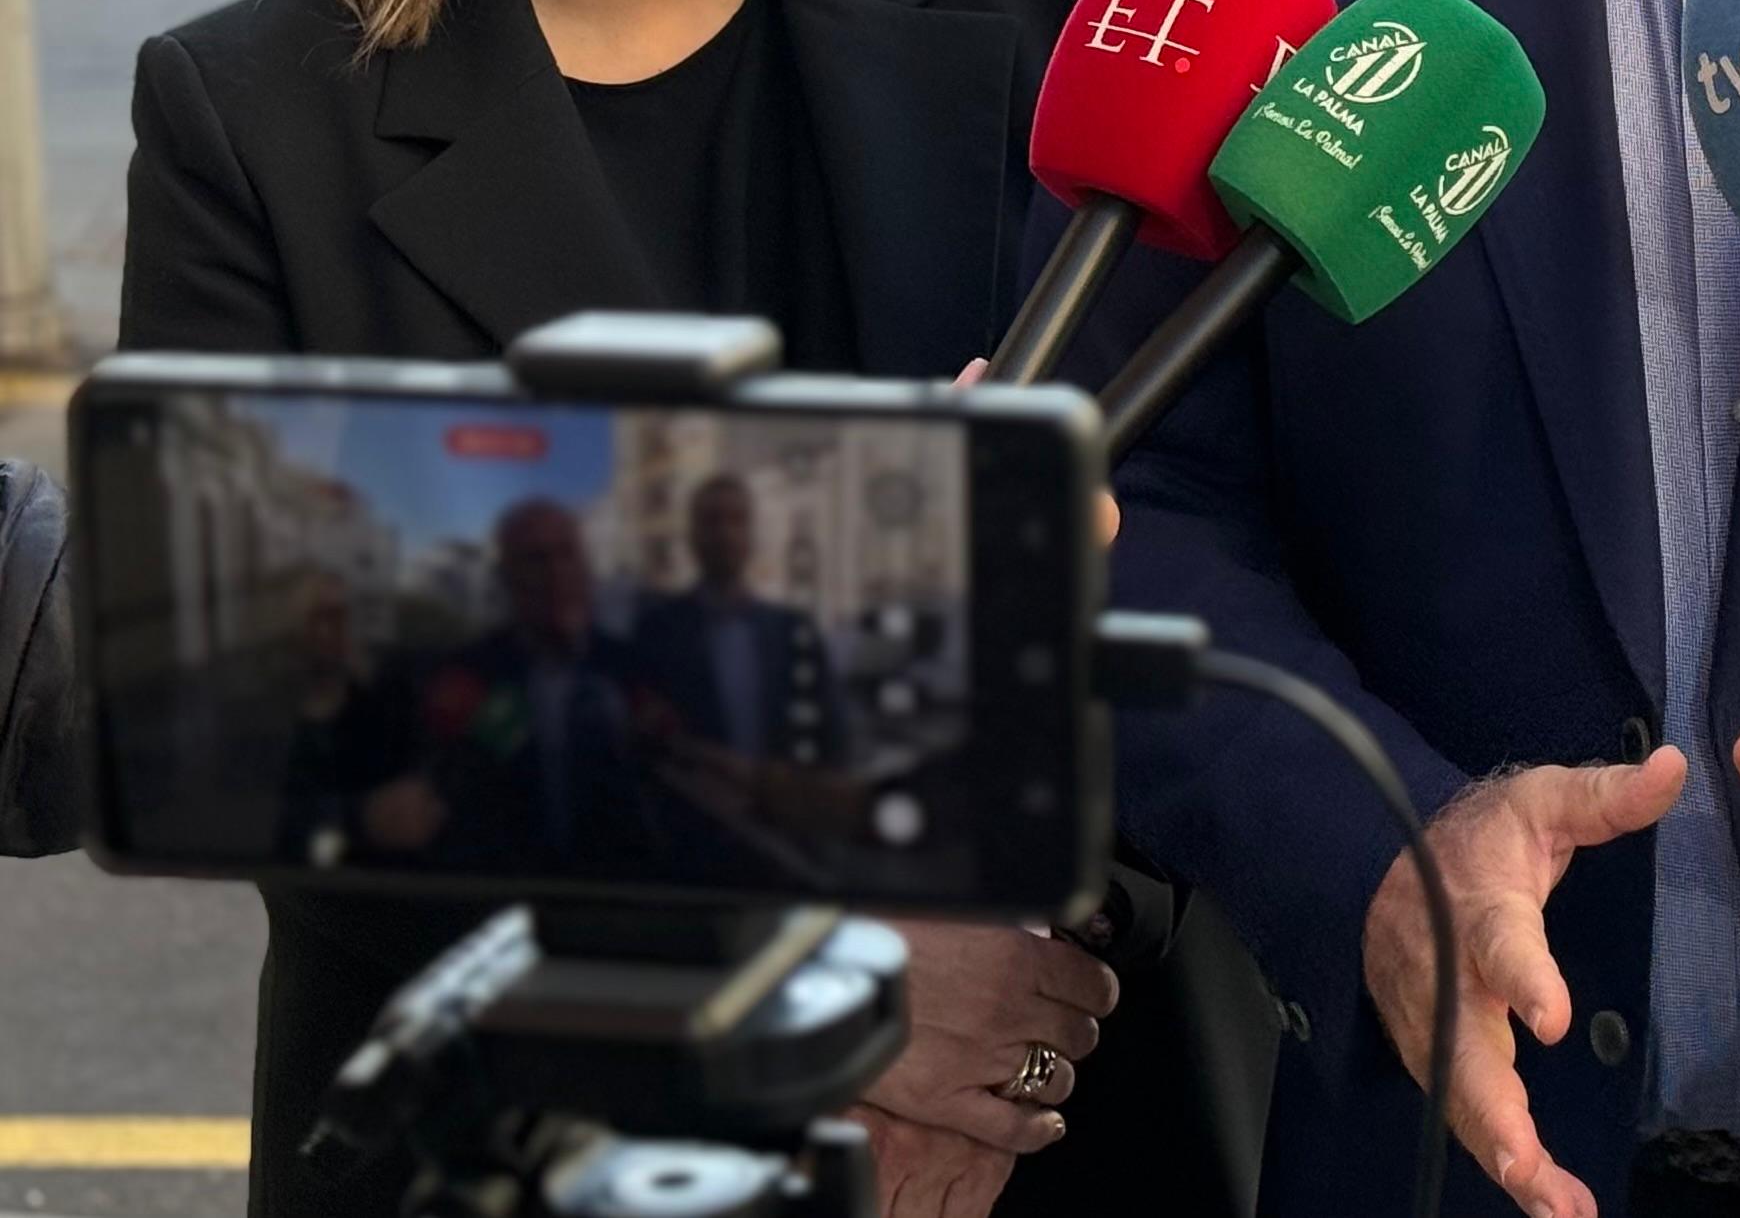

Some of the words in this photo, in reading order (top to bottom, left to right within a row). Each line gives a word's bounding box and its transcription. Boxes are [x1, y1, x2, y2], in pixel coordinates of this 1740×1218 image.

[1329, 31, 1410, 63] CANAL
[1292, 77, 1315, 99] LA
[1313, 89, 1365, 137] PALMA
[1445, 138, 1503, 172] CANAL
[1410, 184, 1429, 209] LA
